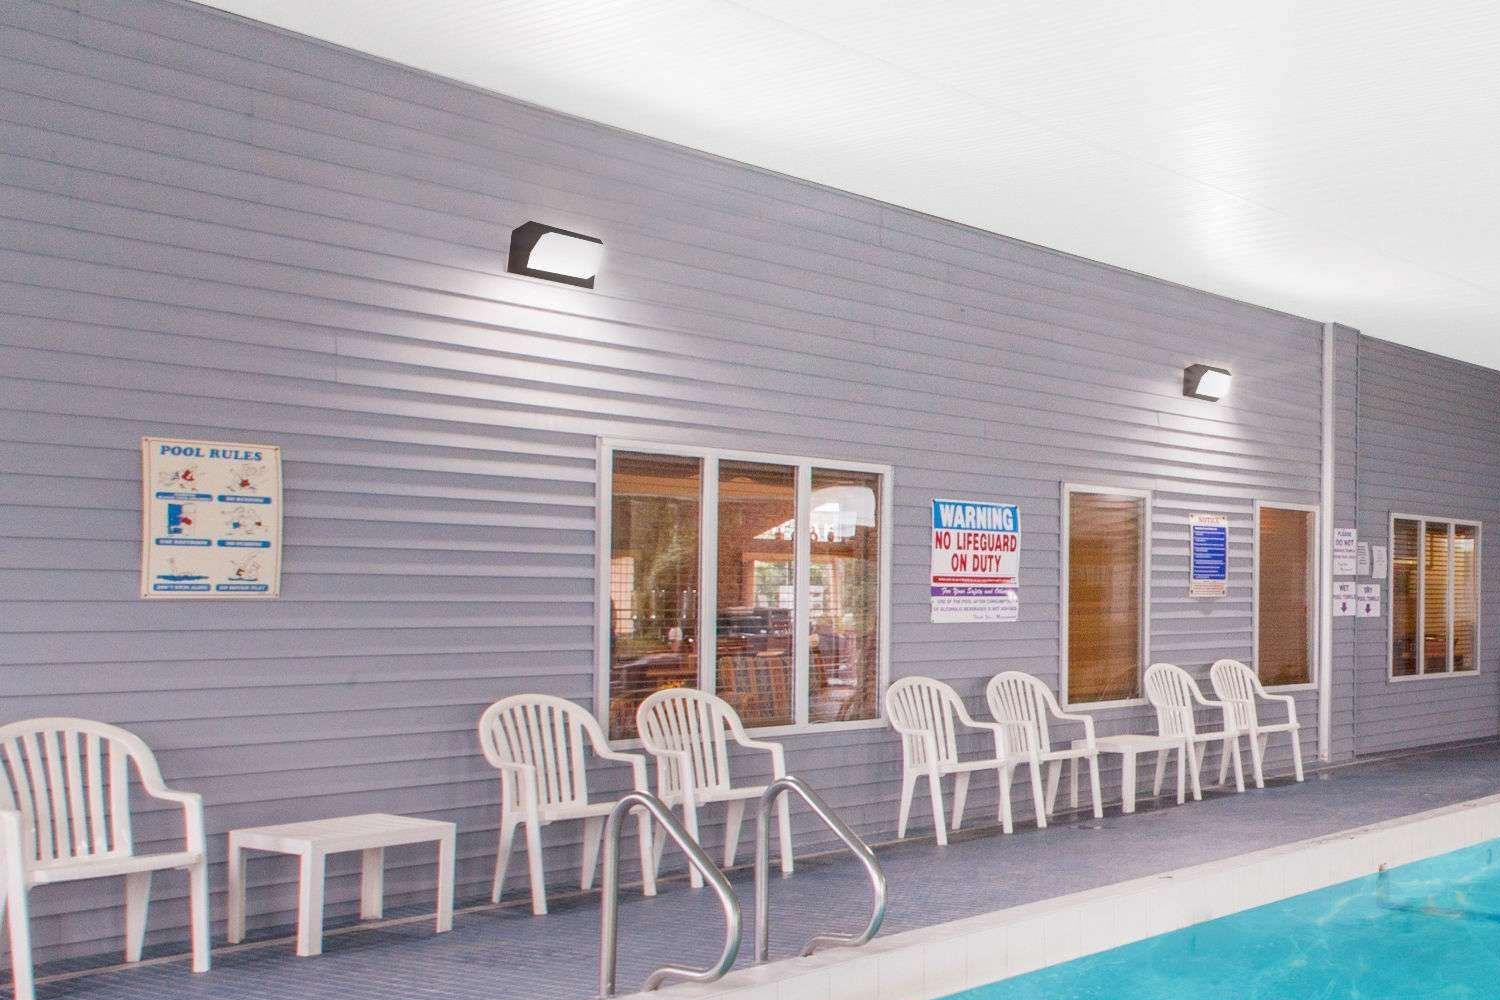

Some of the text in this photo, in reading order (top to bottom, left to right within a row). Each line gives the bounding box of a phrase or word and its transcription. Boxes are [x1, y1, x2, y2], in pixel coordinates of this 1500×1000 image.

[160, 445, 263, 461] POOL RULES
[939, 503, 1014, 531] WARNING
[935, 532, 1017, 552] NO LIFEGUARD
[951, 553, 1002, 573] ON DUTY
